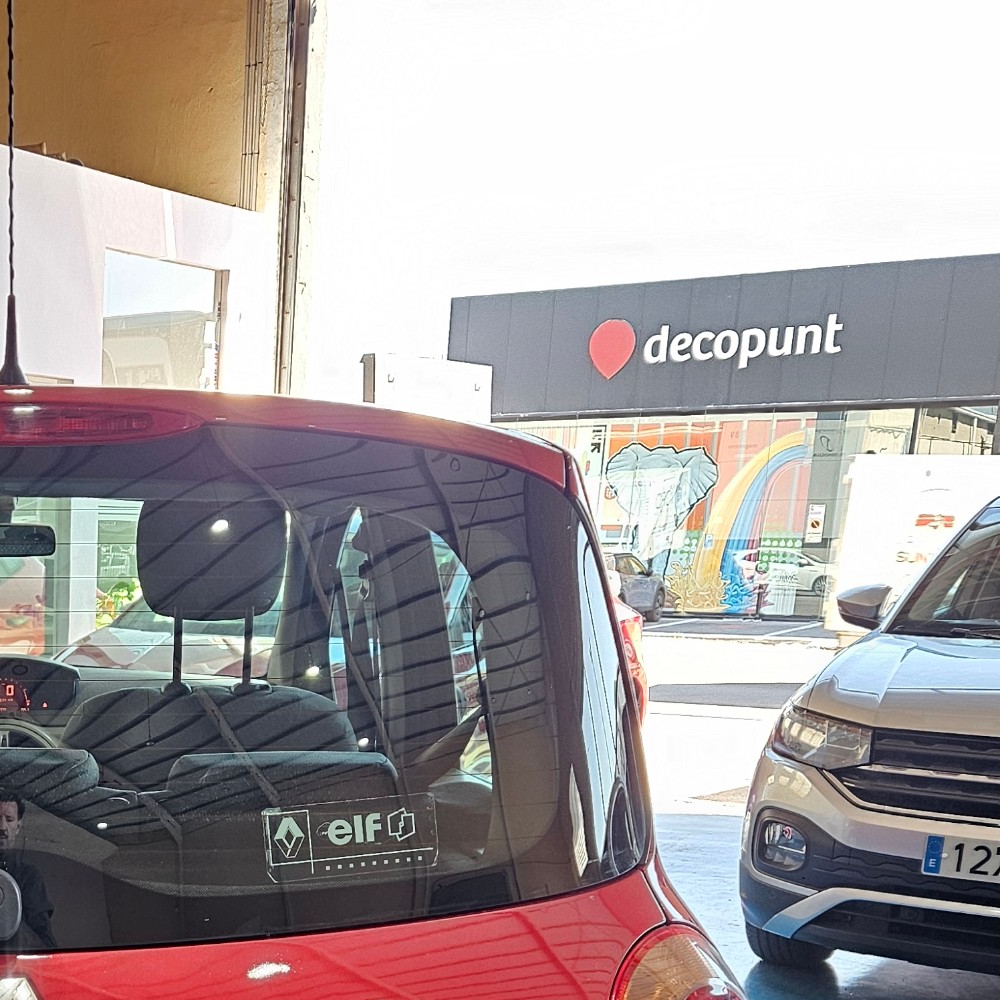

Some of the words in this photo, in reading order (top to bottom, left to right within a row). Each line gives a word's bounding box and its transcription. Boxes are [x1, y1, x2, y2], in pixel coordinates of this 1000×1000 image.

[643, 313, 844, 369] decopunt
[6, 685, 14, 696] 0
[328, 812, 382, 846] elf
[928, 858, 937, 868] E
